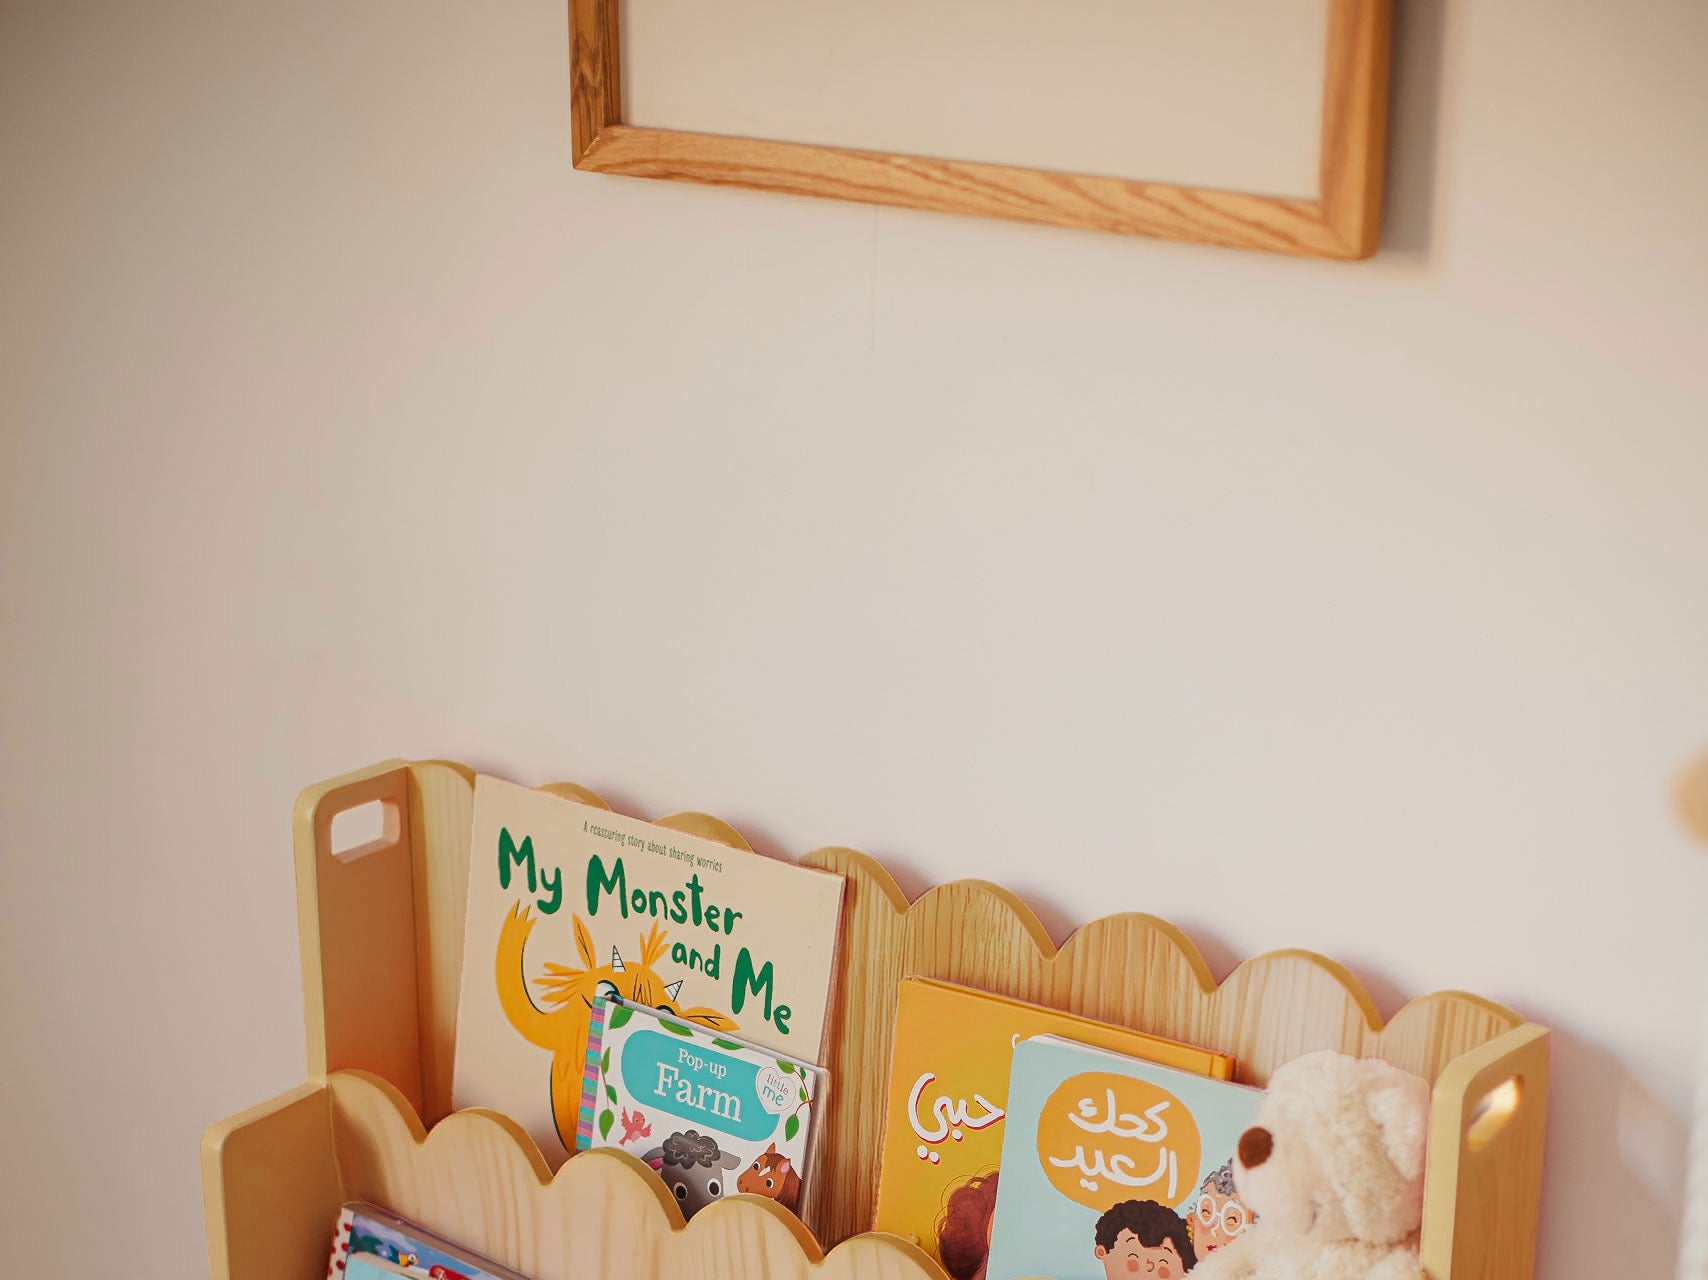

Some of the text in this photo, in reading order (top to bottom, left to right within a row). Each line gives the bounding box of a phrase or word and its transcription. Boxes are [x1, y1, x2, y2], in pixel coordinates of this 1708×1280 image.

[582, 820, 723, 873] A reassuring story about sharing worries
[497, 827, 743, 935] My Monster
[671, 942, 792, 1035] and Me
[677, 1047, 728, 1080] Pop-up
[766, 1073, 789, 1096] little
[653, 1062, 743, 1123] Farm
[762, 1085, 784, 1106] me
[1067, 1088, 1171, 1143] كحك
[1048, 1144, 1178, 1200] العيد
